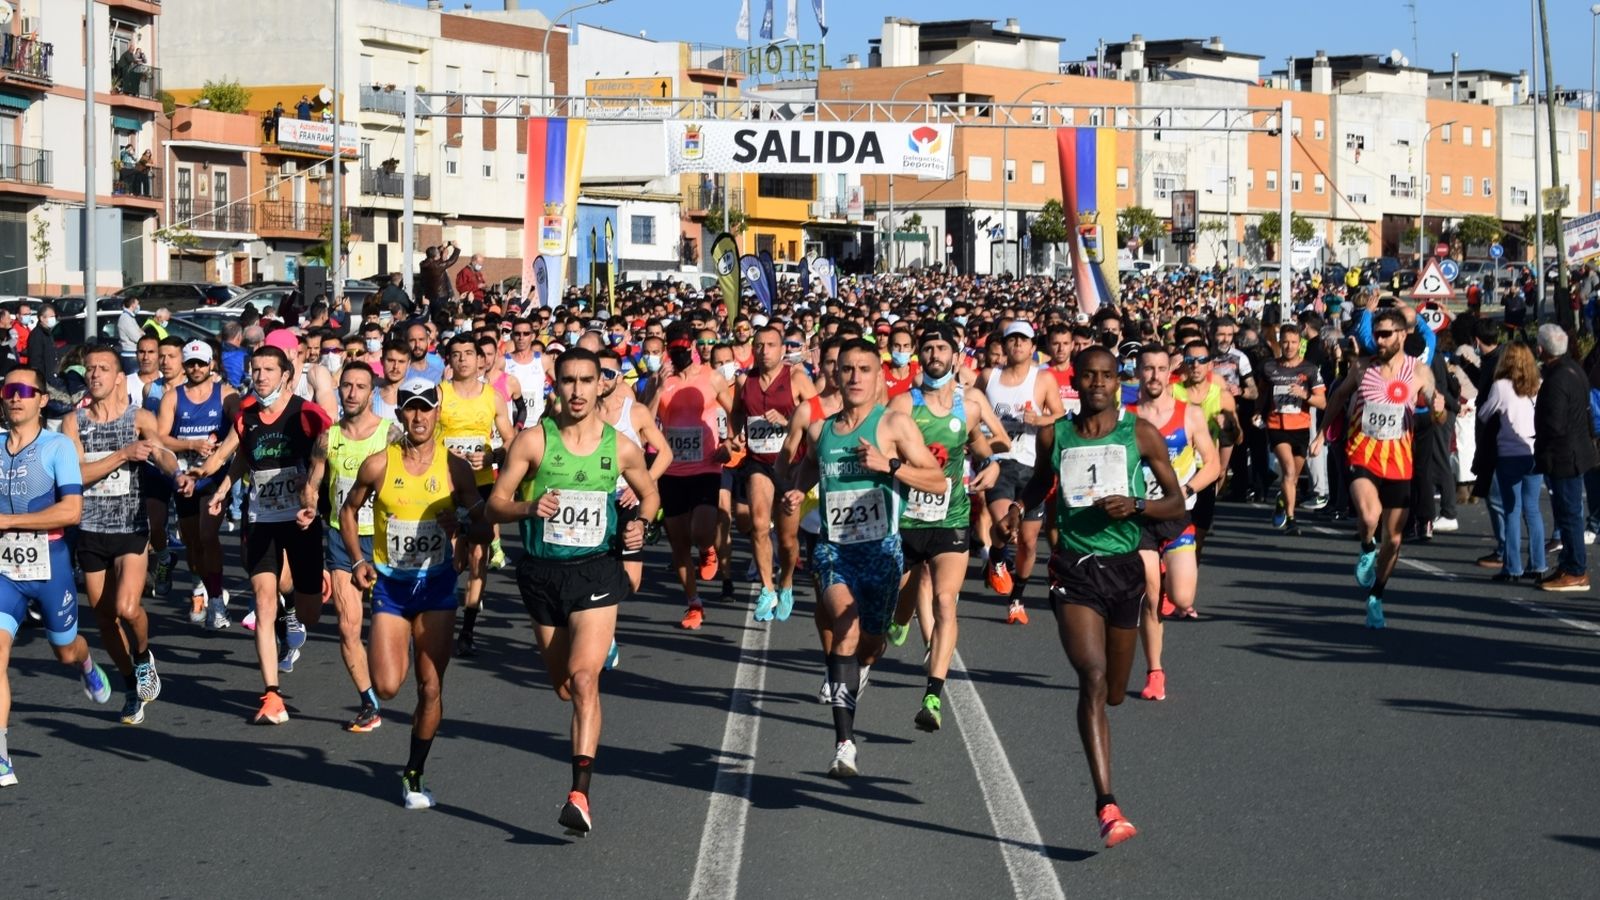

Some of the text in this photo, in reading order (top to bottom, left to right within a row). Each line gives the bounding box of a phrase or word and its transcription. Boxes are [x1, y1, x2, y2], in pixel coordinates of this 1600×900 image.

[747, 44, 832, 75] HOTEL
[299, 131, 316, 141] FRAN
[732, 129, 885, 165] SALIDA
[903, 160, 945, 171] Deportes
[1369, 412, 1396, 427] 895
[669, 436, 700, 450] 1055
[1087, 463, 1097, 484] 1
[547, 506, 601, 527] 2041
[830, 503, 881, 526] 2231
[391, 534, 441, 553] 1862
[1, 546, 38, 565] 469
